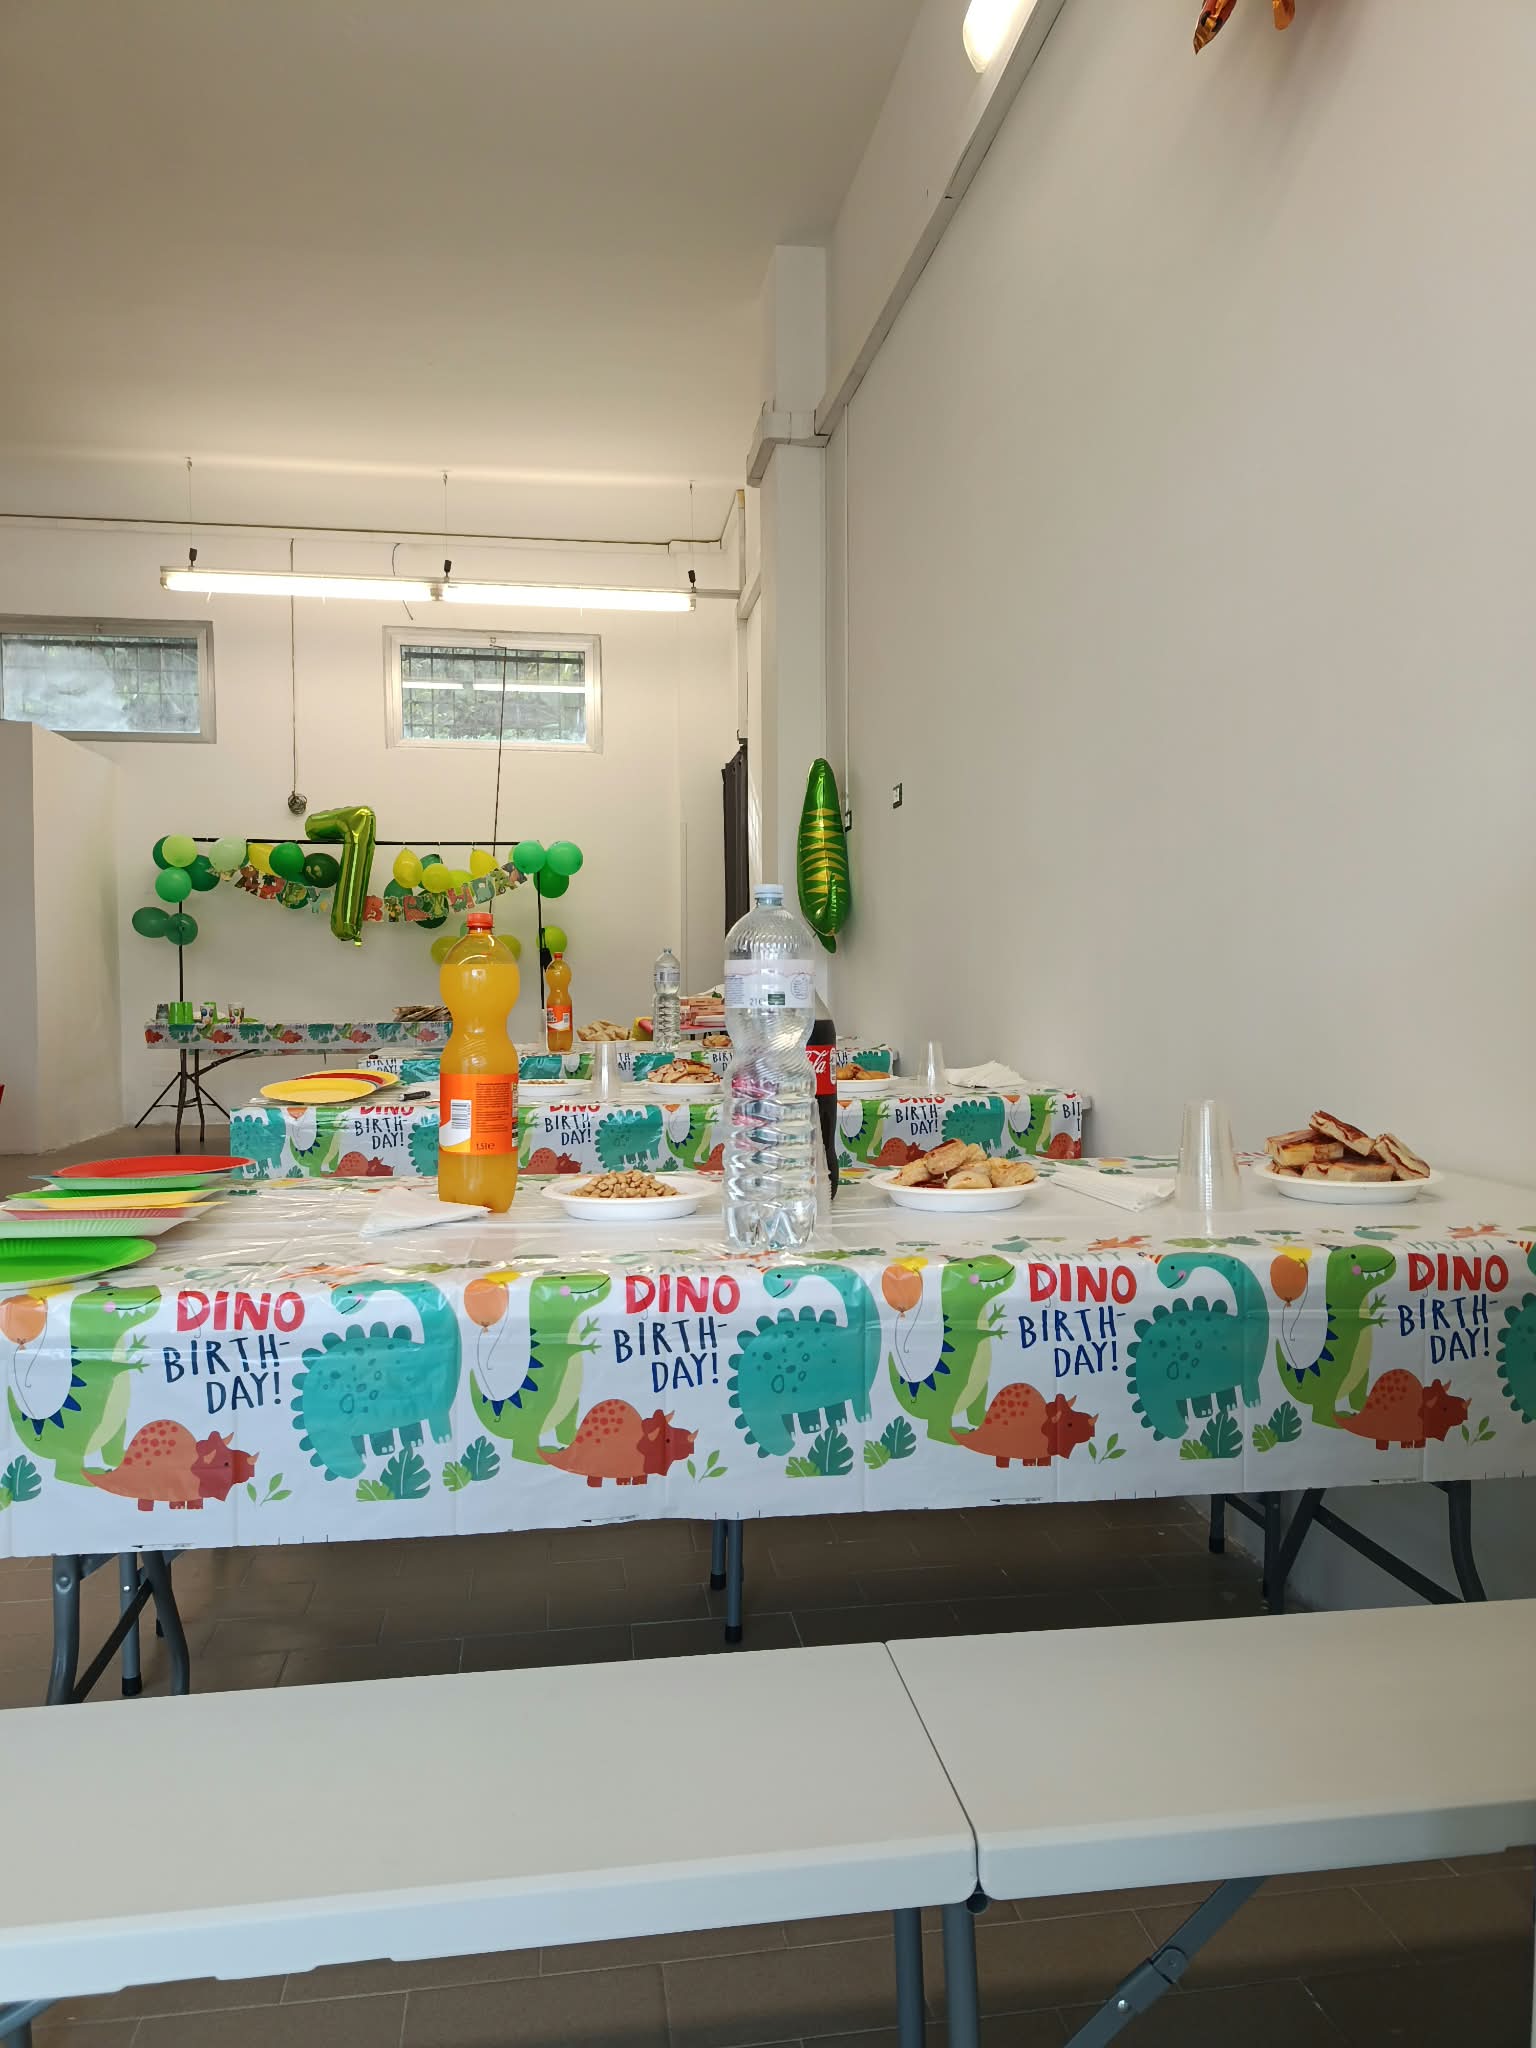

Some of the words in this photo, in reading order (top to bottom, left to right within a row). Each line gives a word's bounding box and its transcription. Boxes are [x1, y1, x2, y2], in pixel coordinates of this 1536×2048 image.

[305, 805, 376, 947] 7
[372, 1131, 404, 1149] DAY!
[561, 1128, 591, 1146] DAY!
[910, 1118, 938, 1135] DAY!
[625, 1273, 741, 1315] DINO
[1028, 1262, 1138, 1305] DINO
[1407, 1253, 1509, 1293] DINO
[176, 1290, 306, 1333] DINO
[1018, 1305, 1127, 1349] BIRTH-
[1397, 1293, 1499, 1337] BIRTH-
[162, 1333, 291, 1384] BIRTH-
[613, 1315, 728, 1364] BIRTH-
[1054, 1340, 1119, 1378] DAY!
[1430, 1326, 1490, 1364] DAY!
[206, 1371, 282, 1415] DAY!
[651, 1352, 719, 1393] DAY!
